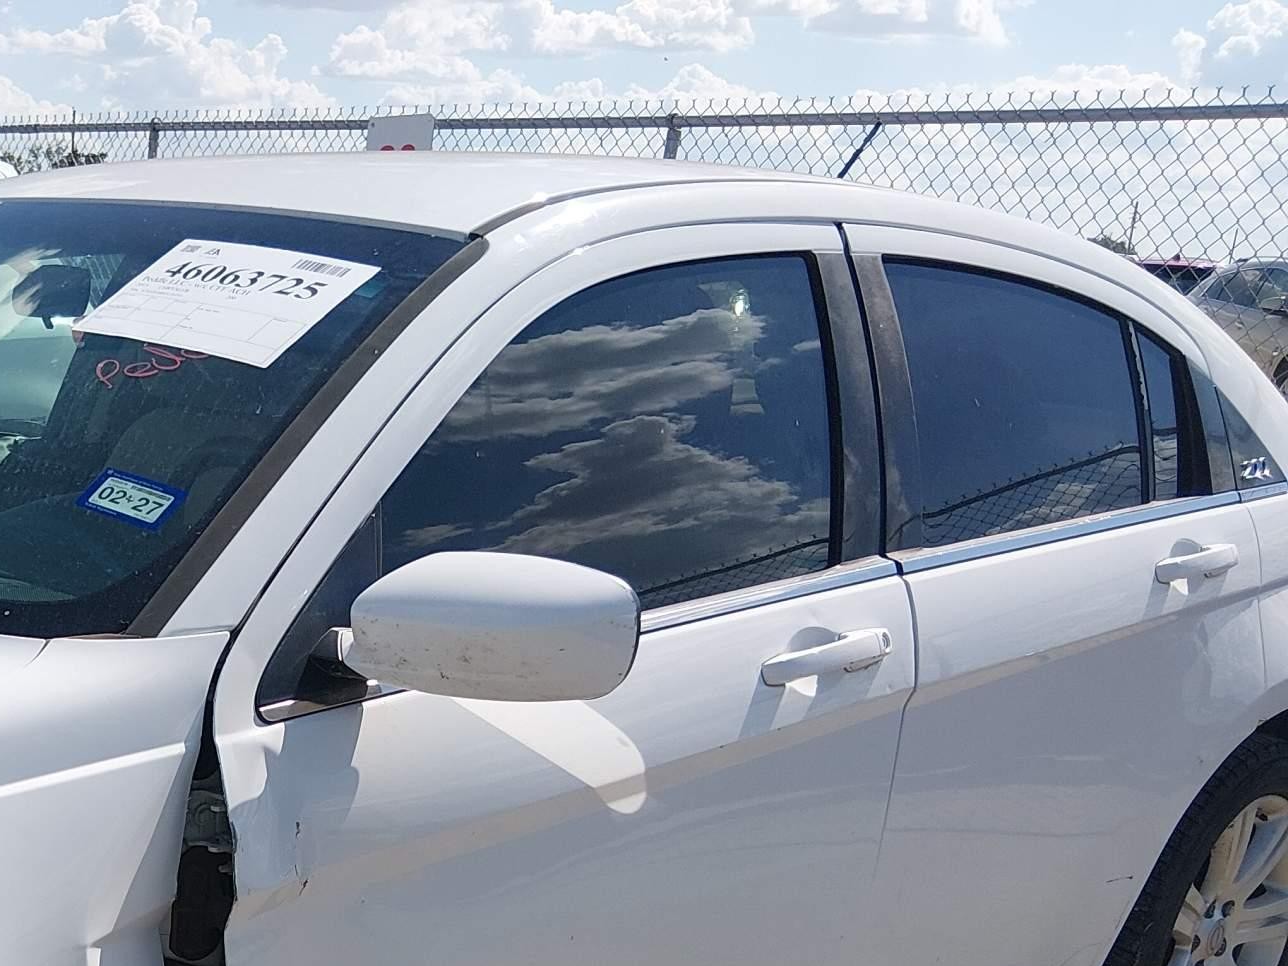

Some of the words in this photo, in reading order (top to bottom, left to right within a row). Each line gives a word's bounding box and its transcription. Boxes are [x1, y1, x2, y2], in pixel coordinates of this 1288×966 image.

[165, 260, 329, 300] 46063725
[98, 486, 128, 505] 02
[131, 497, 165, 515] 27
